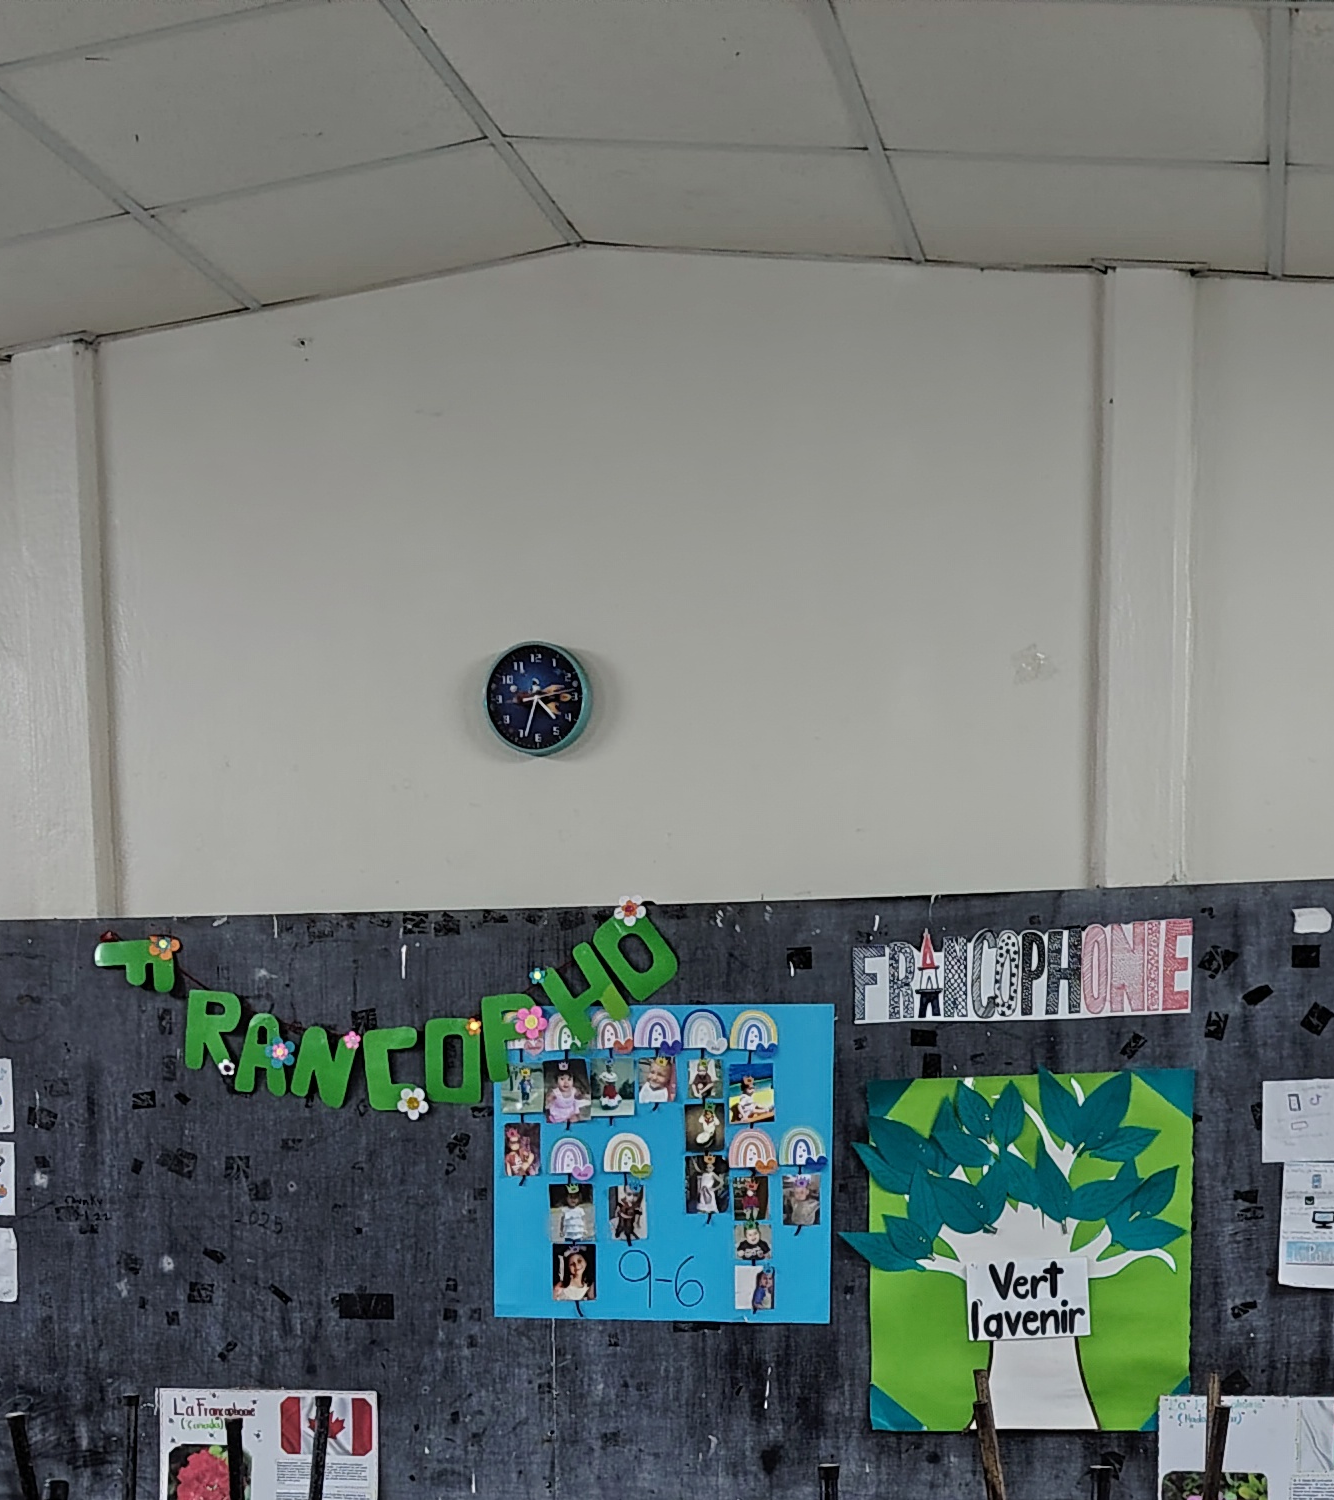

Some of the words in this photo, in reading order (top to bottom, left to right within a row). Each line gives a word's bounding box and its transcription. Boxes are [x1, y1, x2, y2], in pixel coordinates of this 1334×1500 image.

[530, 653, 542, 663] 12
[552, 658, 557, 667] 1
[513, 661, 525, 673] 11
[502, 675, 513, 684] 10
[564, 673, 572, 682] 2
[496, 695, 503, 704] 9
[571, 692, 578, 702] 3
[564, 713, 572, 722] 4
[552, 726, 560, 736] 5
[535, 733, 542, 743] 6
[852, 918, 1193, 1021] FRANCOPHONIE
[617, 1249, 705, 1310] 9-6
[989, 1261, 1065, 1301] Vert
[970, 1298, 1086, 1341] l'avenir
[174, 1398, 194, 1416] La
